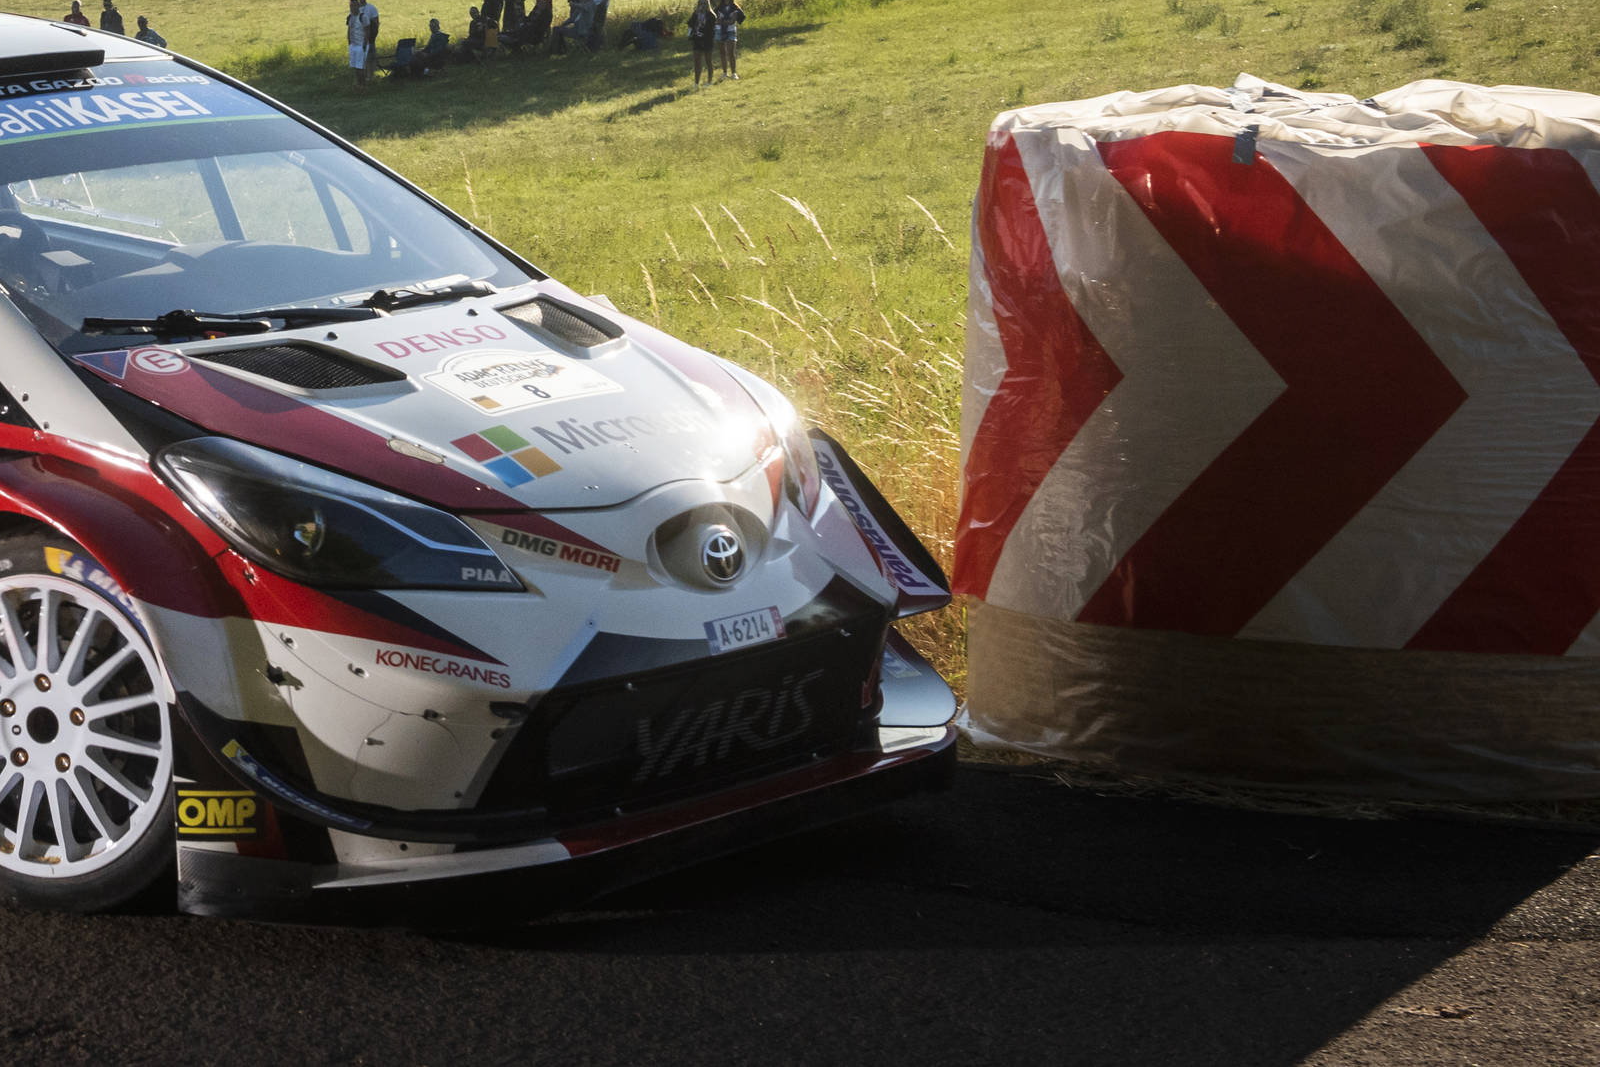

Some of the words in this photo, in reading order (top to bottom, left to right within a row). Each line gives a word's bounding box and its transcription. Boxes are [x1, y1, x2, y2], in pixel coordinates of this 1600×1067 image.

[29, 75, 124, 96] GAZOO
[124, 72, 211, 86] Racing
[374, 322, 508, 360] DENSO
[142, 353, 175, 369] E
[454, 367, 498, 383] ADAC
[522, 384, 551, 399] 8
[815, 450, 931, 590] Panasonic
[502, 528, 558, 557] DMG
[559, 545, 622, 574] MORI
[461, 567, 512, 583] PIAA
[376, 649, 511, 689] KONECRANES
[631, 668, 825, 783] YARIS
[178, 797, 257, 827] OMP
